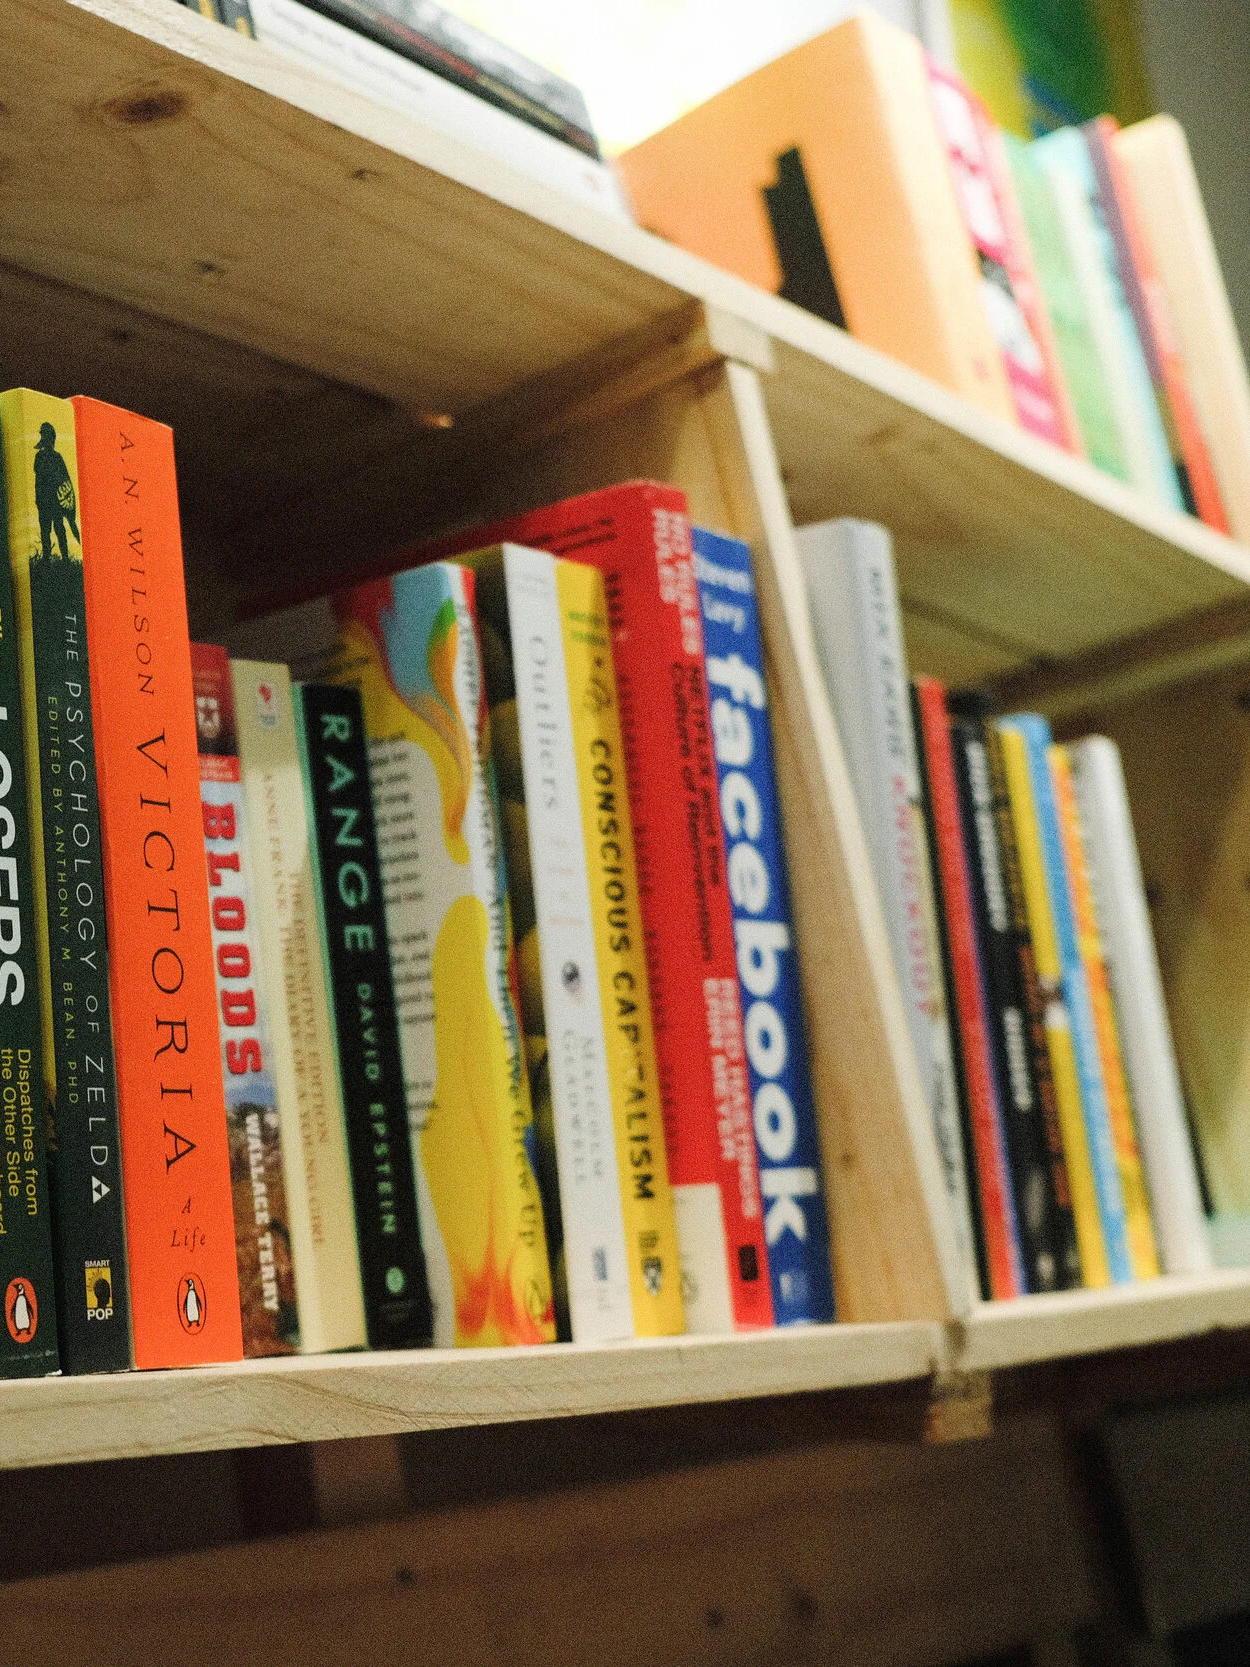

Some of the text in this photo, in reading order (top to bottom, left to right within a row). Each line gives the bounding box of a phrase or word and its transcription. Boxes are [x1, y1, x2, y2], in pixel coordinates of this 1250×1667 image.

[64, 614, 79, 662] THE
[128, 527, 155, 695] WILSON
[48, 696, 62, 775] EDITED
[529, 634, 556, 811] Outliers
[53, 788, 64, 813] BY
[63, 681, 97, 970] PSYCHOLOGY
[54, 826, 70, 933] ANTHONY
[136, 727, 198, 1175] VICTORIA
[203, 802, 262, 1075] BLOODS
[706, 653, 819, 1246] facebook
[86, 995, 100, 1033] OF
[321, 714, 396, 1233] RANGE DAVID EPSTEIN
[589, 738, 631, 955] CONSCIOUS
[613, 970, 656, 1202] CAPALISM
[1, 1048, 19, 1197] the Other Side
[18, 1049, 38, 1215] Dispatches from
[67, 1061, 79, 1104] PHD
[84, 1260, 111, 1268] SMART
[170, 1229, 206, 1253] Life
[181, 1197, 192, 1214] A
[245, 1111, 281, 1312] WALLACE TERRY
[87, 1307, 113, 1321] POP
